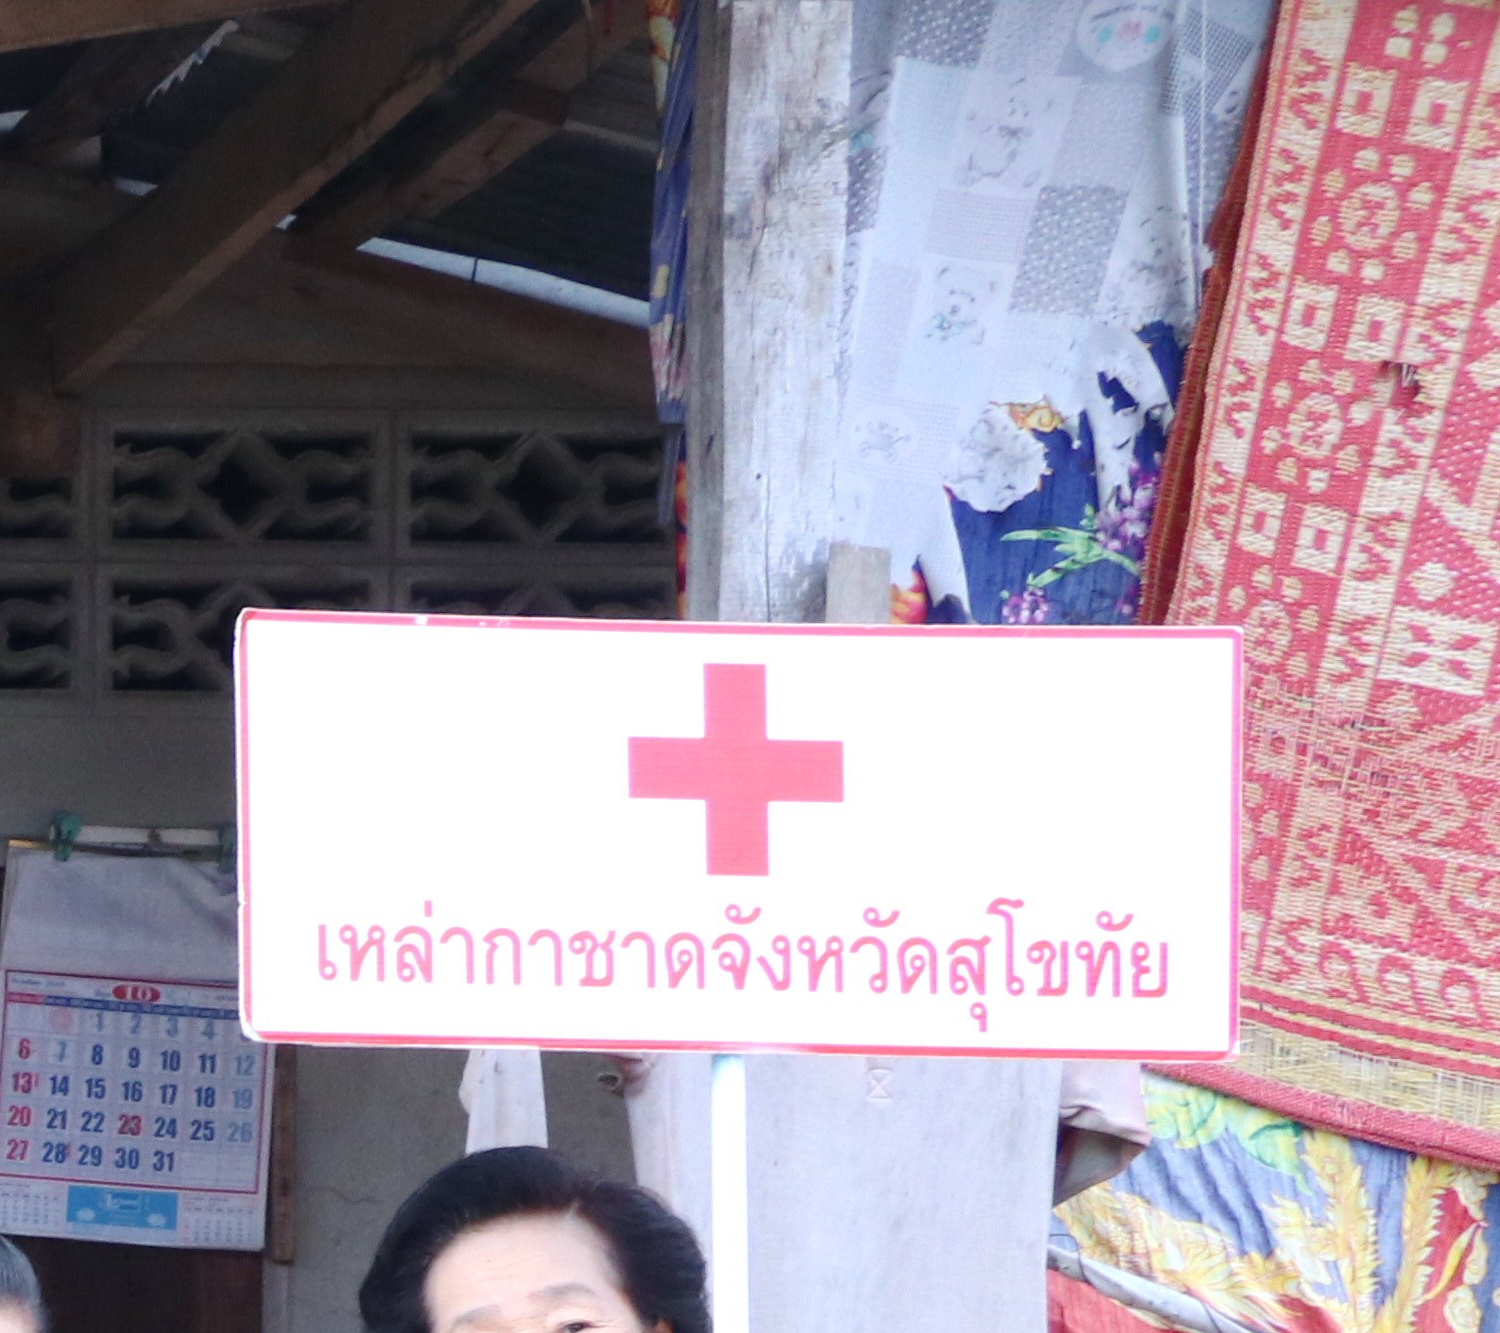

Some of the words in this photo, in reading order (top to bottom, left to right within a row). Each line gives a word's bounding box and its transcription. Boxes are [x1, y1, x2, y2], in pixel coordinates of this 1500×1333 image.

[315, 896, 1172, 1033] เหล่ากาชาดจังหวัดสุโขทัย
[126, 986, 153, 1001] 10
[18, 1039, 31, 1060] 6
[91, 1044, 104, 1065] 8
[128, 1047, 141, 1069] 9
[161, 1050, 181, 1072] 10
[198, 1053, 216, 1075] 11
[12, 1073, 32, 1094] 13
[50, 1075, 70, 1096] 14
[85, 1078, 106, 1100] 15
[122, 1081, 143, 1102] 16
[159, 1084, 178, 1105] 17
[195, 1086, 215, 1108] 18
[7, 1105, 31, 1127] 20
[47, 1109, 67, 1130] 21
[81, 1112, 104, 1133] 22
[118, 1115, 142, 1136] 23
[155, 1117, 177, 1139] 24
[190, 1120, 215, 1142] 25
[228, 1122, 253, 1143] 26
[6, 1139, 29, 1160] 27
[42, 1142, 67, 1163] 28
[78, 1145, 102, 1167] 29
[115, 1148, 140, 1170] 30
[153, 1150, 175, 1172] 31
